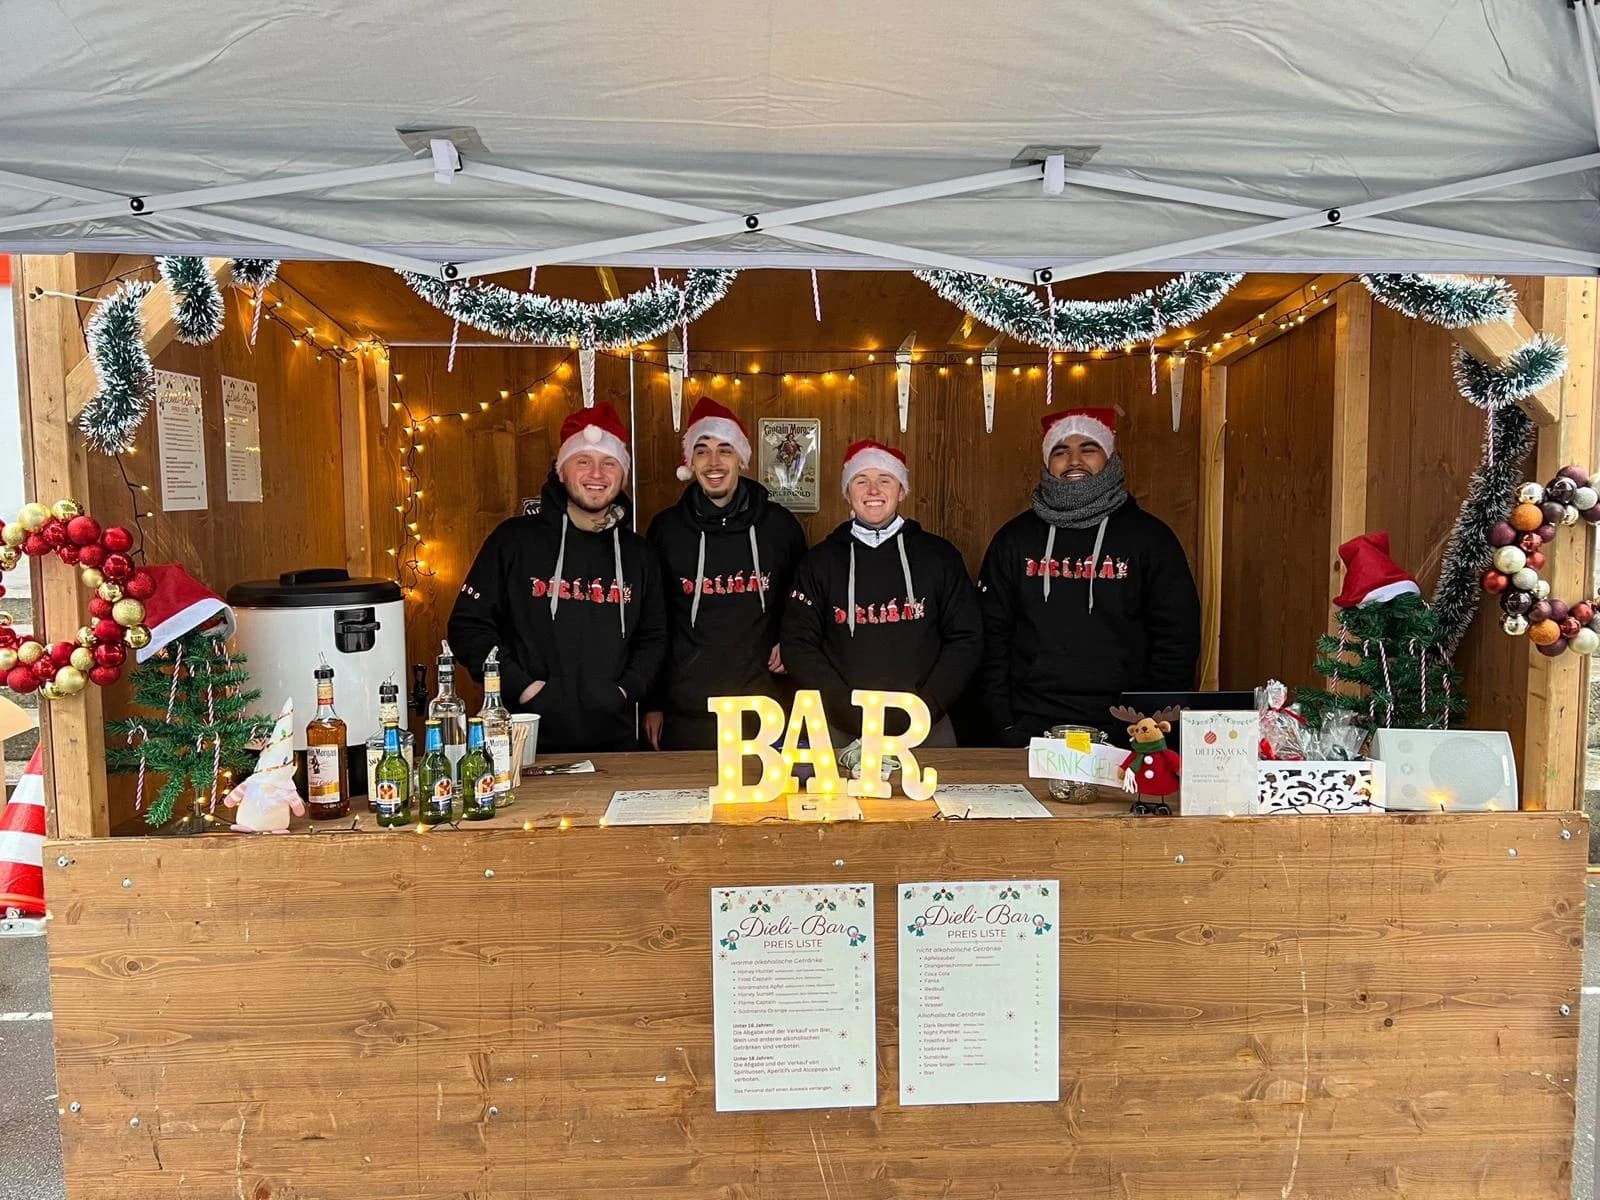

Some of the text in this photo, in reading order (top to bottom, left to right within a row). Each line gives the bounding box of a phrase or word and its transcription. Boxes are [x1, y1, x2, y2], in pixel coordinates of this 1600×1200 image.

[764, 424, 789, 436] Captain
[707, 689, 937, 804] BAR
[925, 904, 1031, 926] Dieli-Bar
[740, 914, 846, 938] Dieli-Bar
[948, 930, 1007, 938] PREIS LISTE
[764, 939, 823, 949] PREIS LISTE
